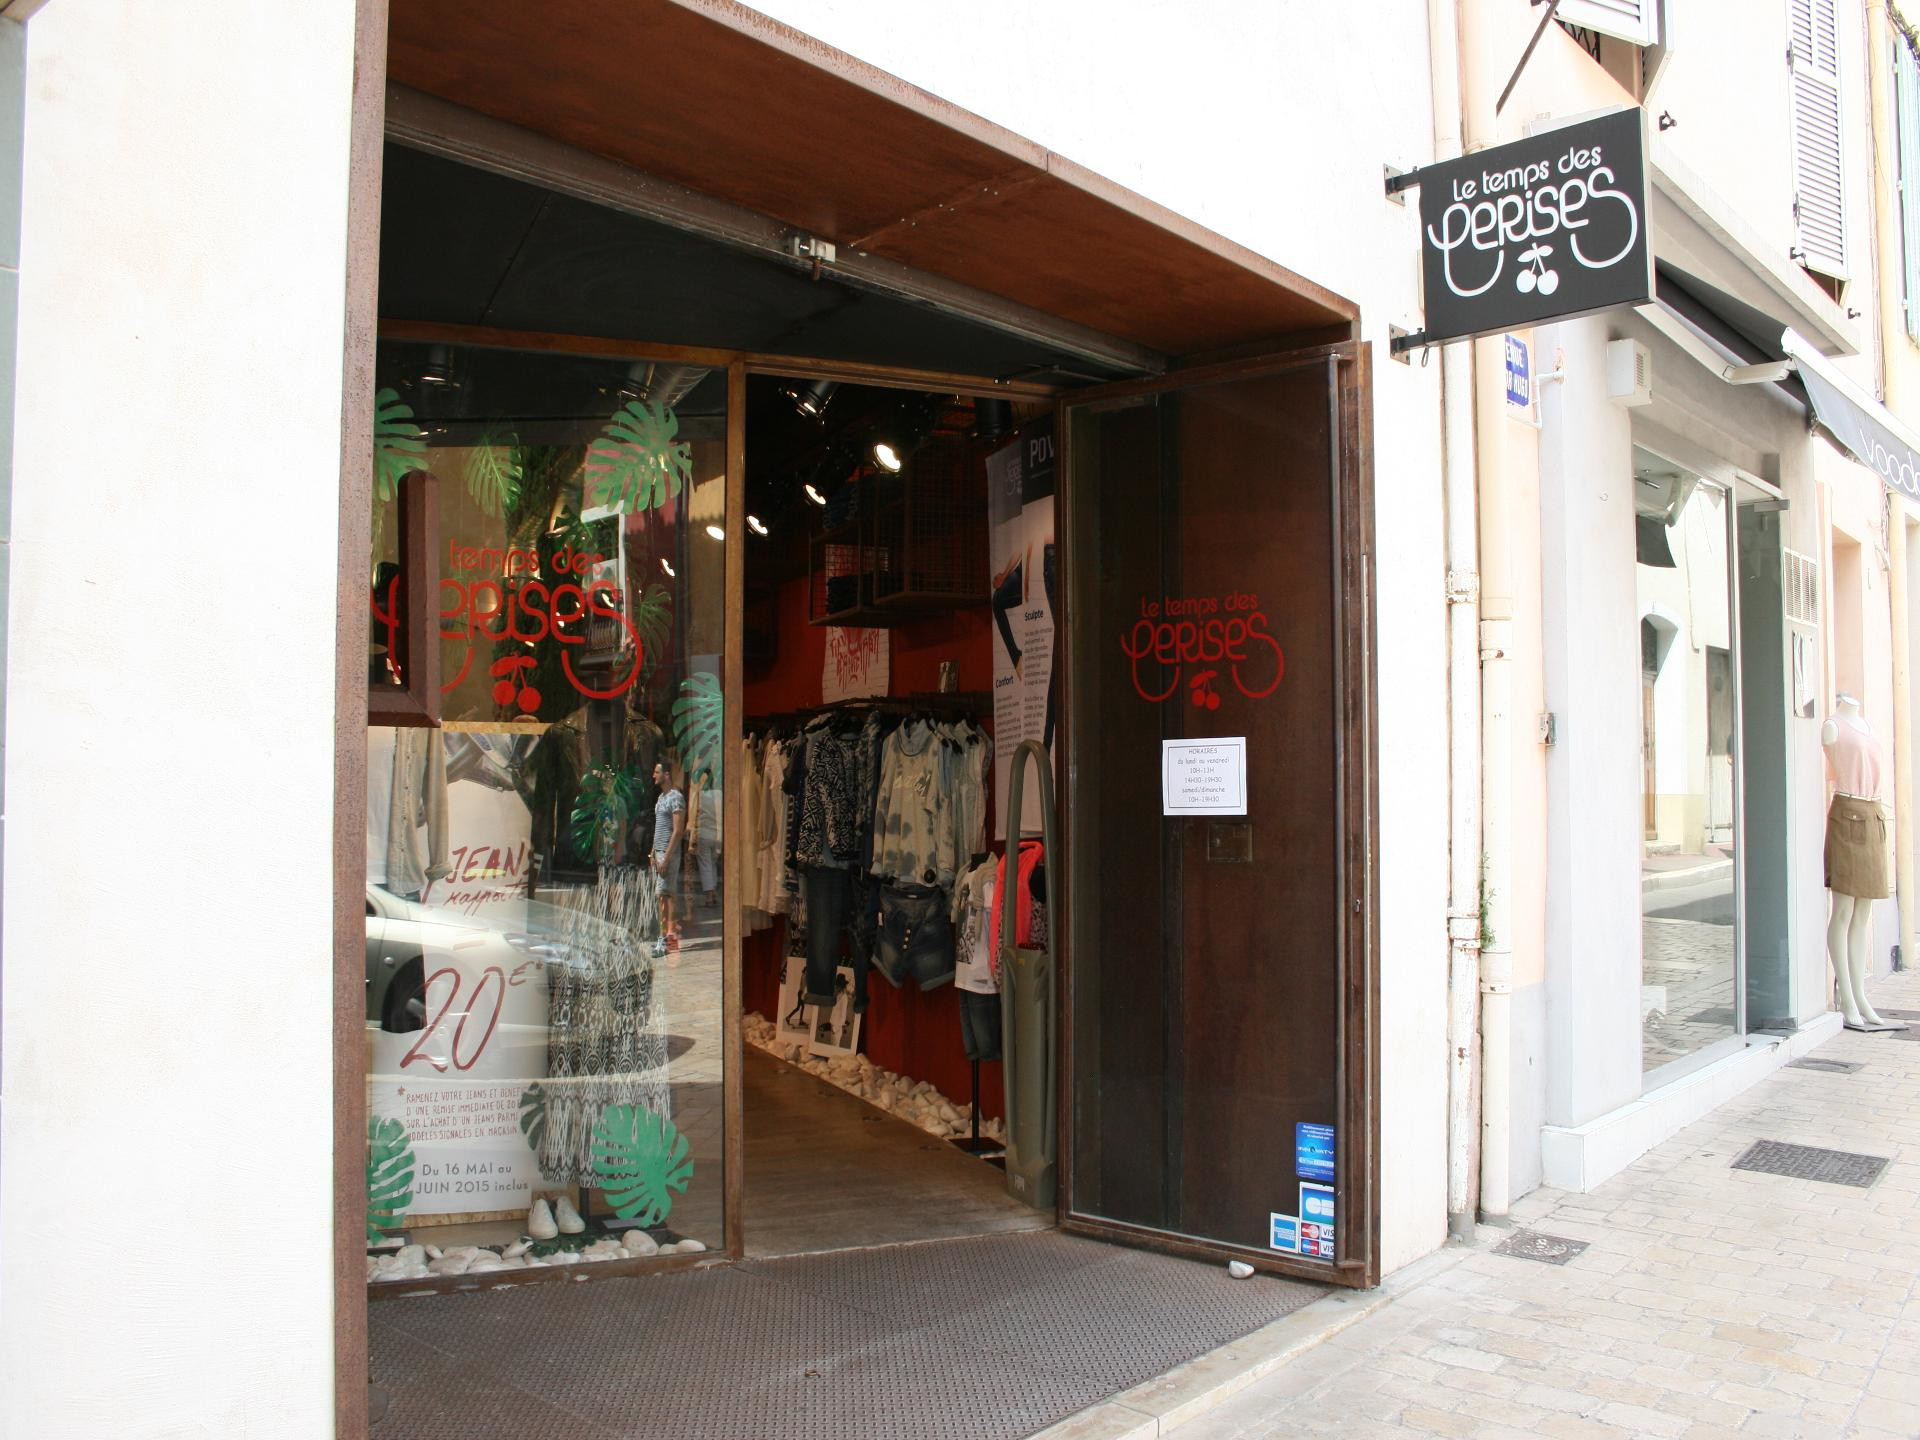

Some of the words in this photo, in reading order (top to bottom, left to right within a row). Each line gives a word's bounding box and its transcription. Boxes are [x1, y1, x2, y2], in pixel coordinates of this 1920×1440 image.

[1482, 159, 1550, 196] temps
[1558, 145, 1602, 175] des
[449, 537, 541, 578] temps
[551, 545, 605, 575] des
[1165, 595, 1219, 618] temps
[1225, 591, 1258, 612] des
[995, 675, 1015, 689] Confort
[1207, 756, 1230, 765] vendredi
[406, 1092, 439, 1104] RAMENEZ
[441, 1090, 462, 1102] VOTRE
[466, 1089, 487, 1100] JEANS
[489, 1088, 497, 1099] ET
[432, 1104, 456, 1115] REMISE
[457, 1102, 495, 1114] IMMEDIATE
[496, 1101, 505, 1110] DE
[406, 1118, 421, 1129] SUR
[475, 1114, 495, 1125] JEANS
[497, 1112, 519, 1123] PARMI
[406, 1130, 438, 1142] MODELES
[439, 1128, 473, 1141] SIGNALES
[475, 1127, 484, 1138] EN
[488, 1125, 518, 1137] MAGASIN
[422, 1163, 439, 1176] Du
[446, 1162, 460, 1175] 16
[466, 1161, 493, 1175] MAI
[498, 1165, 512, 1174] au
[416, 1181, 450, 1195] JUIN
[455, 1180, 490, 1193] 2015
[494, 1178, 529, 1192] inclus
